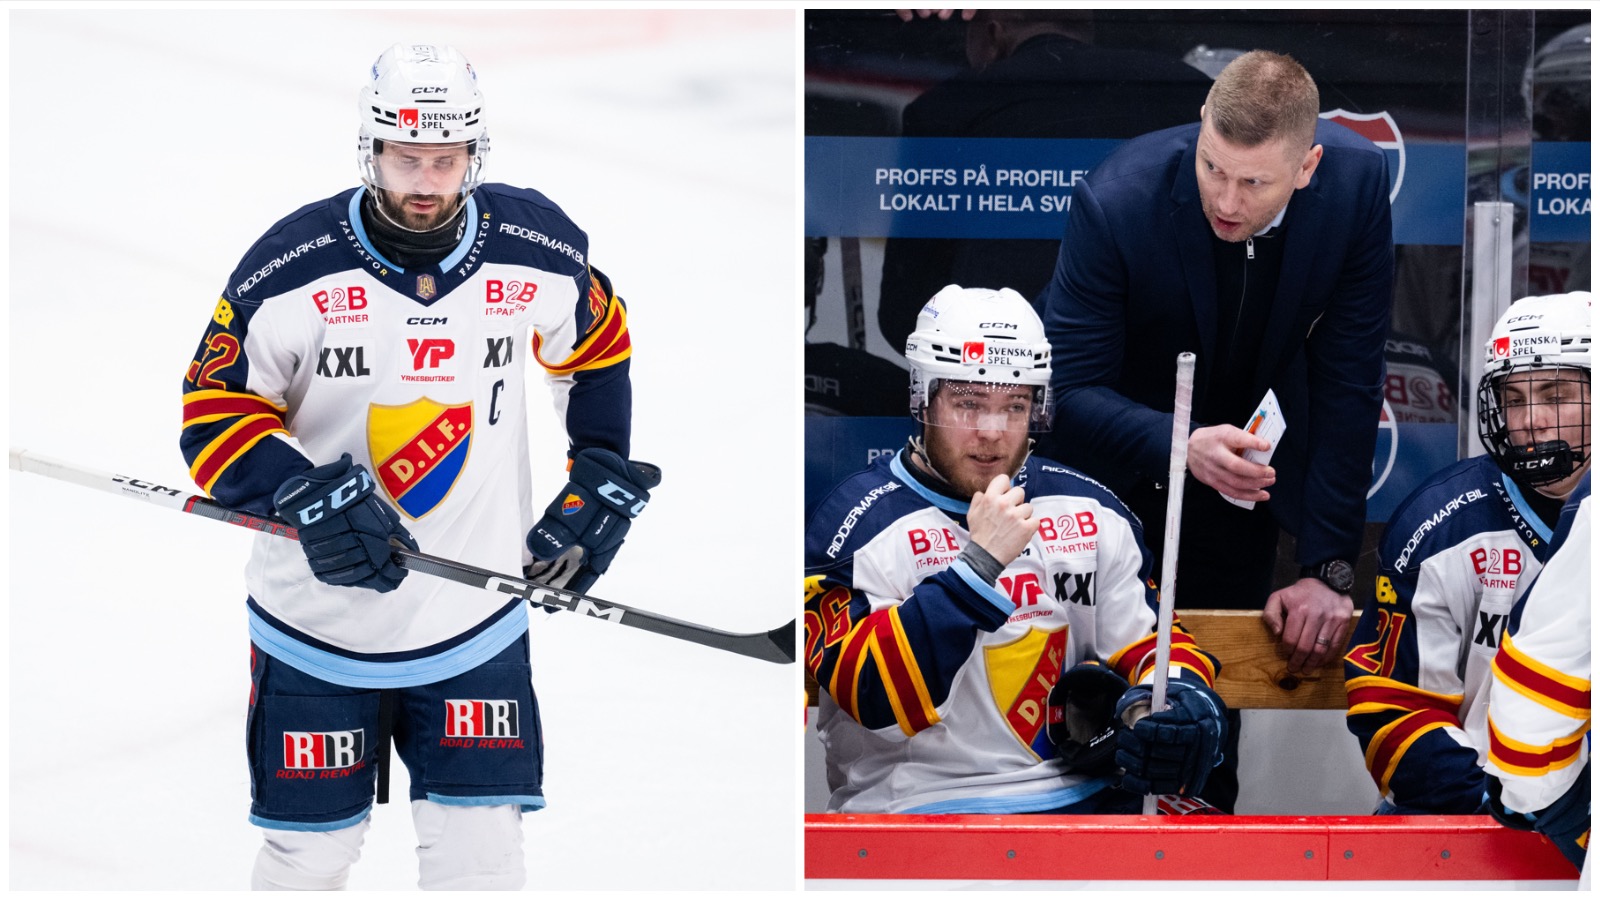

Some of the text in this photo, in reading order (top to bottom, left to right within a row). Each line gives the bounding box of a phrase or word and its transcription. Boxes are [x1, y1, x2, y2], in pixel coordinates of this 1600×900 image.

[411, 86, 448, 94] CCM
[421, 112, 464, 121] SVENSKA
[421, 121, 445, 129] SPEL
[875, 168, 957, 186] PROFFS
[963, 163, 991, 186] PÅ
[1533, 172, 1591, 190] PROF
[879, 193, 961, 211] LOKALT
[966, 194, 972, 211] I
[978, 194, 1035, 212] HELA
[339, 219, 388, 277] FASTATOR
[458, 212, 491, 277] FASTATOR
[499, 222, 575, 260] RIDDERMARK
[573, 251, 585, 267] BIL
[236, 233, 337, 298] RIDDERMARK BIL
[311, 285, 368, 315] B2B
[485, 279, 538, 305] B2B
[406, 316, 448, 325] CCM
[978, 322, 1018, 330] CCM
[1506, 314, 1544, 325] CCM
[987, 346, 1033, 358] SVENSKA
[1512, 336, 1558, 348] SVENSKA
[1512, 346, 1536, 357] SPEL
[315, 346, 371, 379] XXL
[406, 338, 456, 372] YP
[987, 356, 1012, 366] SPEL
[400, 374, 456, 383] YRKESBUTIKER
[488, 378, 505, 426] C
[826, 485, 887, 559] RIDDERMARK
[1037, 511, 1098, 542] B2B
[1394, 488, 1488, 574] RIDDERMARK BIL
[537, 527, 563, 549] CCM
[1469, 547, 1522, 575] B2B
[484, 576, 626, 625] CCM
[1342, 607, 1408, 679] 21
[439, 737, 525, 749] ROAD RENTAL
[275, 761, 366, 780] ROAD RENTAL
